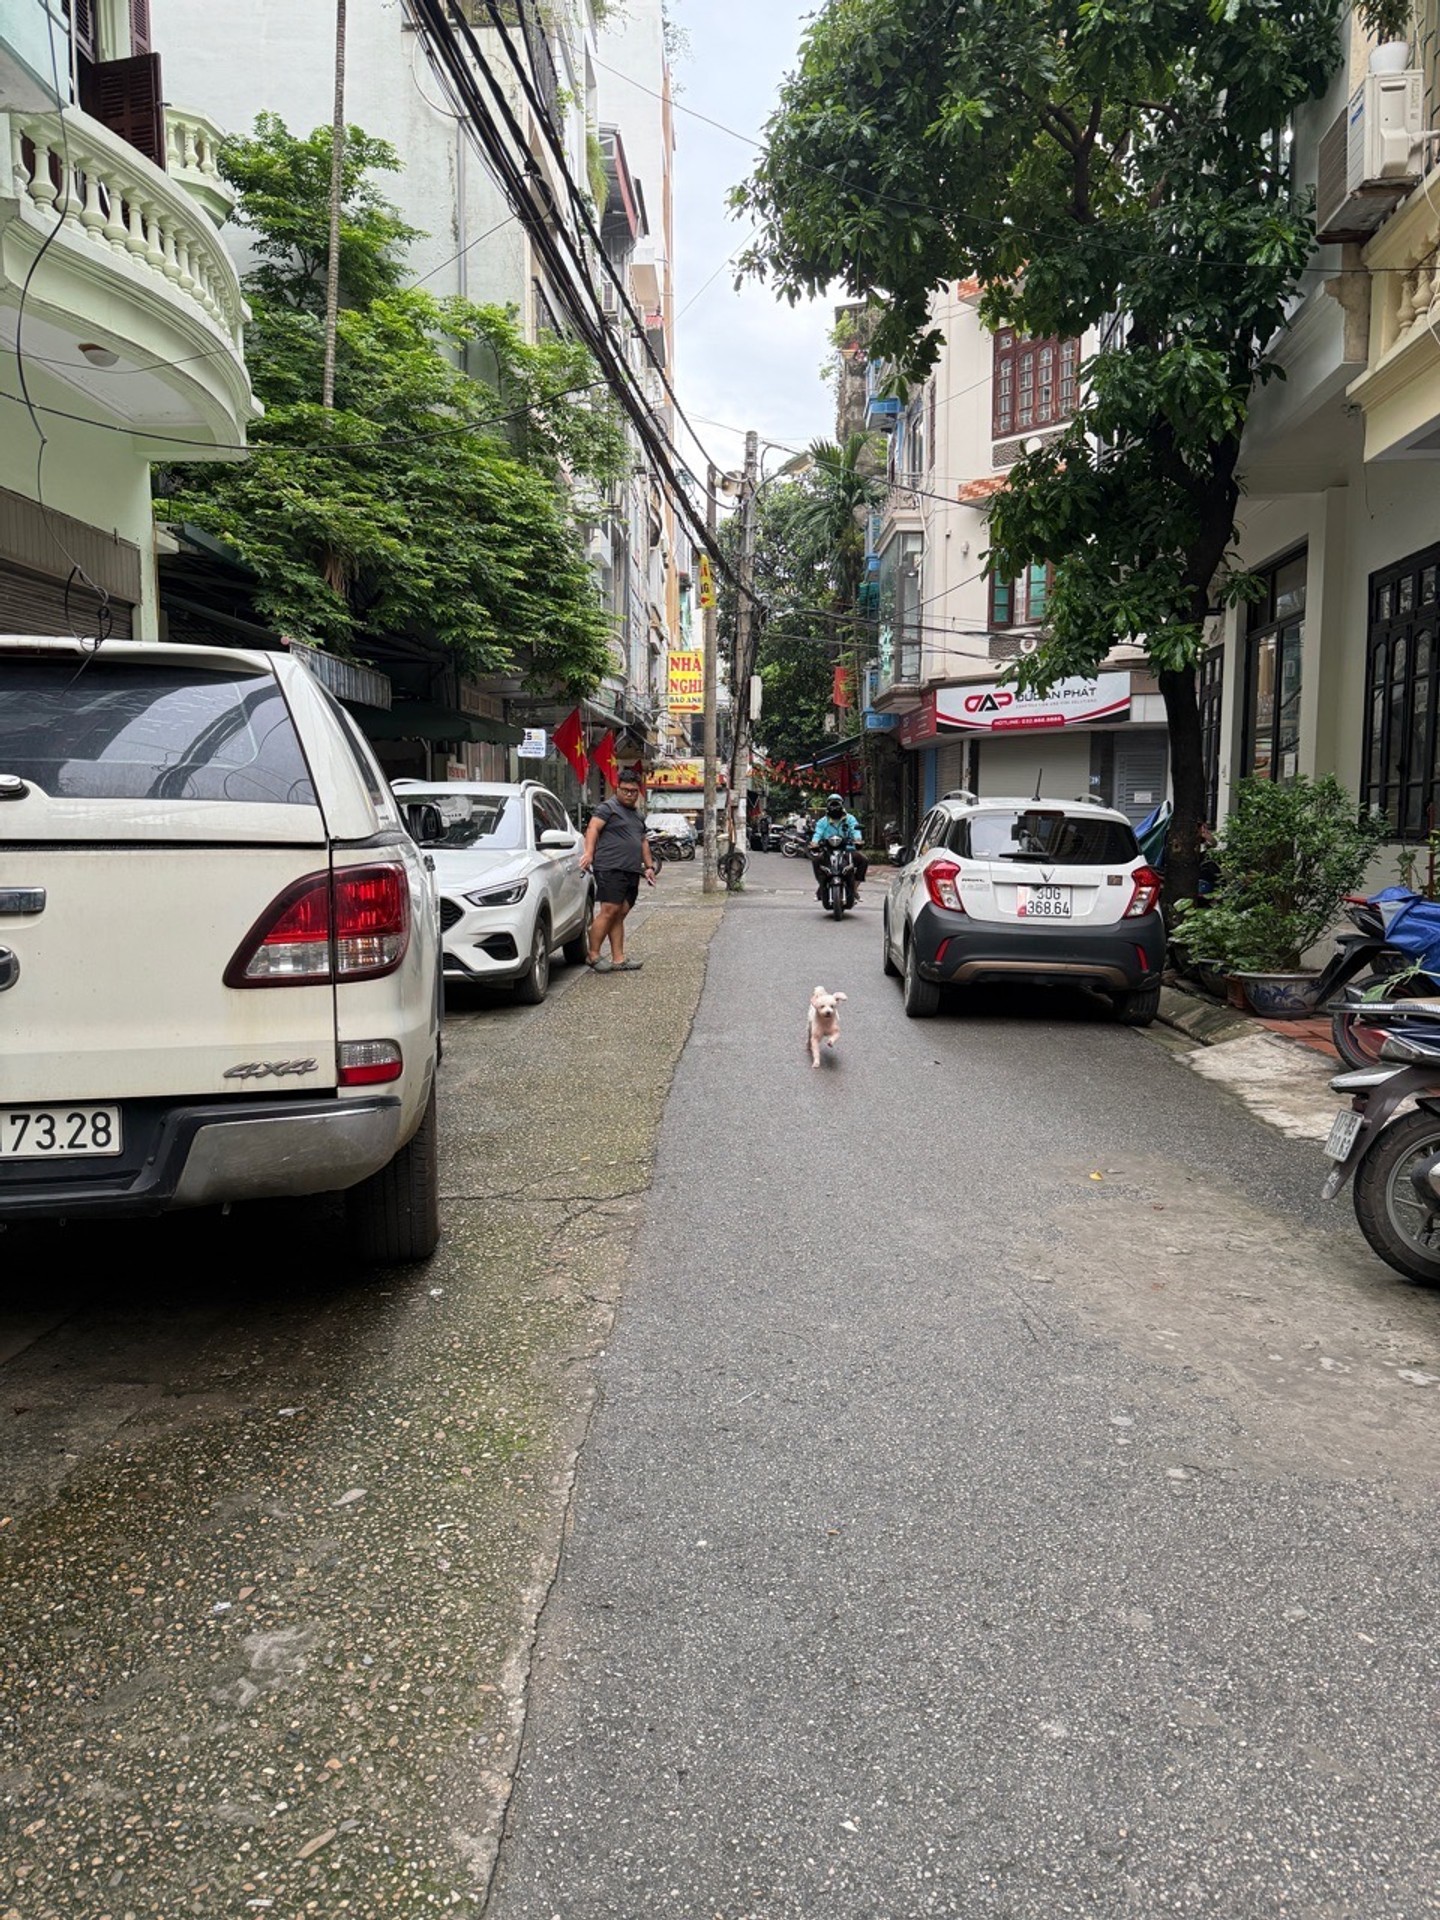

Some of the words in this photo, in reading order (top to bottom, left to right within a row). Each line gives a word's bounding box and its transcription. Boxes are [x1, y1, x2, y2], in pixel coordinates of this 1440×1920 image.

[670, 653, 702, 672] NHÀ
[669, 673, 703, 694] NGHỈ
[1063, 686, 1097, 699] PHÁT
[1037, 887, 1061, 899] 30G
[1027, 901, 1070, 915] 368.64
[0, 1112, 112, 1151] 73.28
